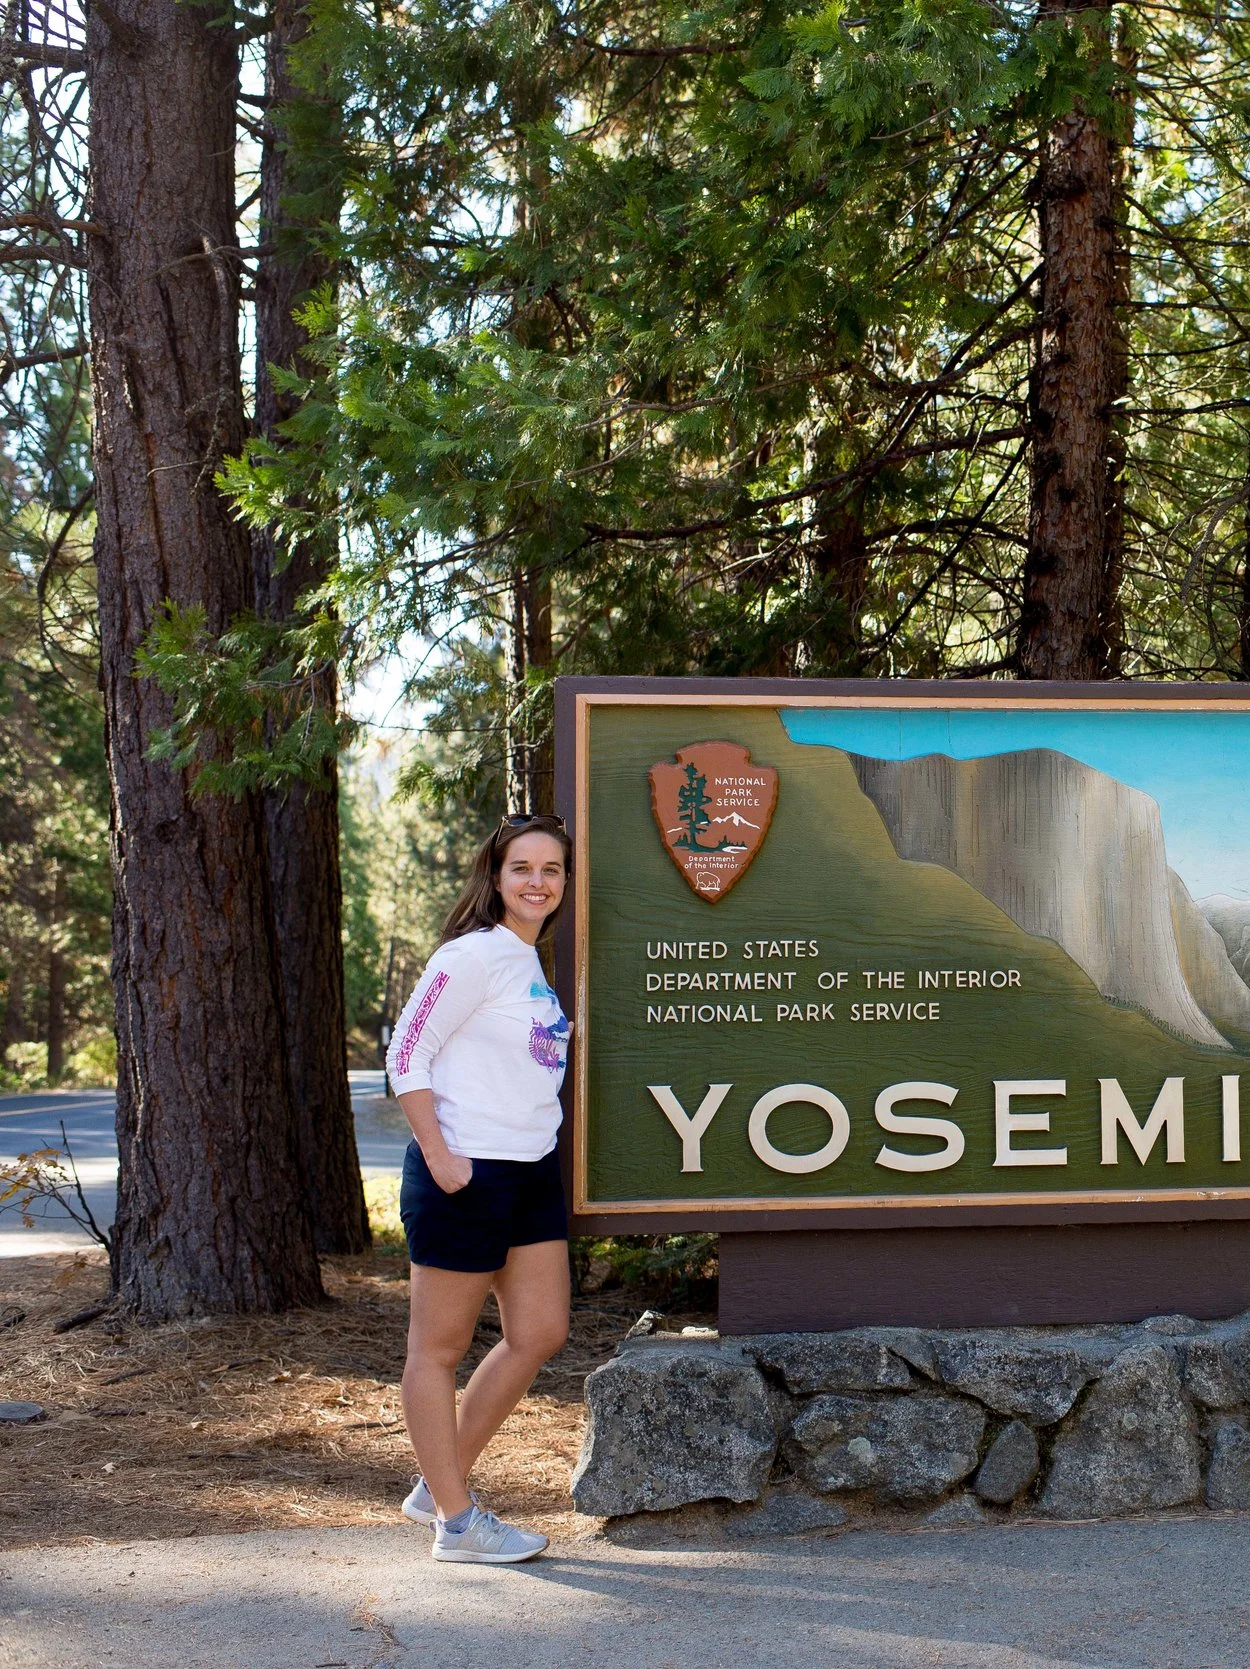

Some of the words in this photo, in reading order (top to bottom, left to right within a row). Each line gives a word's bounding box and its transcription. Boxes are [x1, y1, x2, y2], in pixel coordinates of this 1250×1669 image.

[714, 777, 767, 786] NATIONAL
[725, 788, 752, 796] PARK
[716, 798, 760, 807] SERVICE
[688, 855, 735, 863] Department
[684, 861, 693, 869] of
[694, 861, 707, 869] the
[709, 860, 739, 869] Interior
[646, 941, 728, 960] UNITED
[743, 940, 819, 959] STATES
[646, 971, 797, 992] DEPARTMENT
[817, 971, 849, 990] OF
[862, 971, 905, 989] THE
[918, 969, 1022, 989] INTERIOR
[646, 1004, 763, 1023] NATIONAL
[777, 1003, 835, 1022] PARK
[850, 1002, 940, 1021] SERVICE
